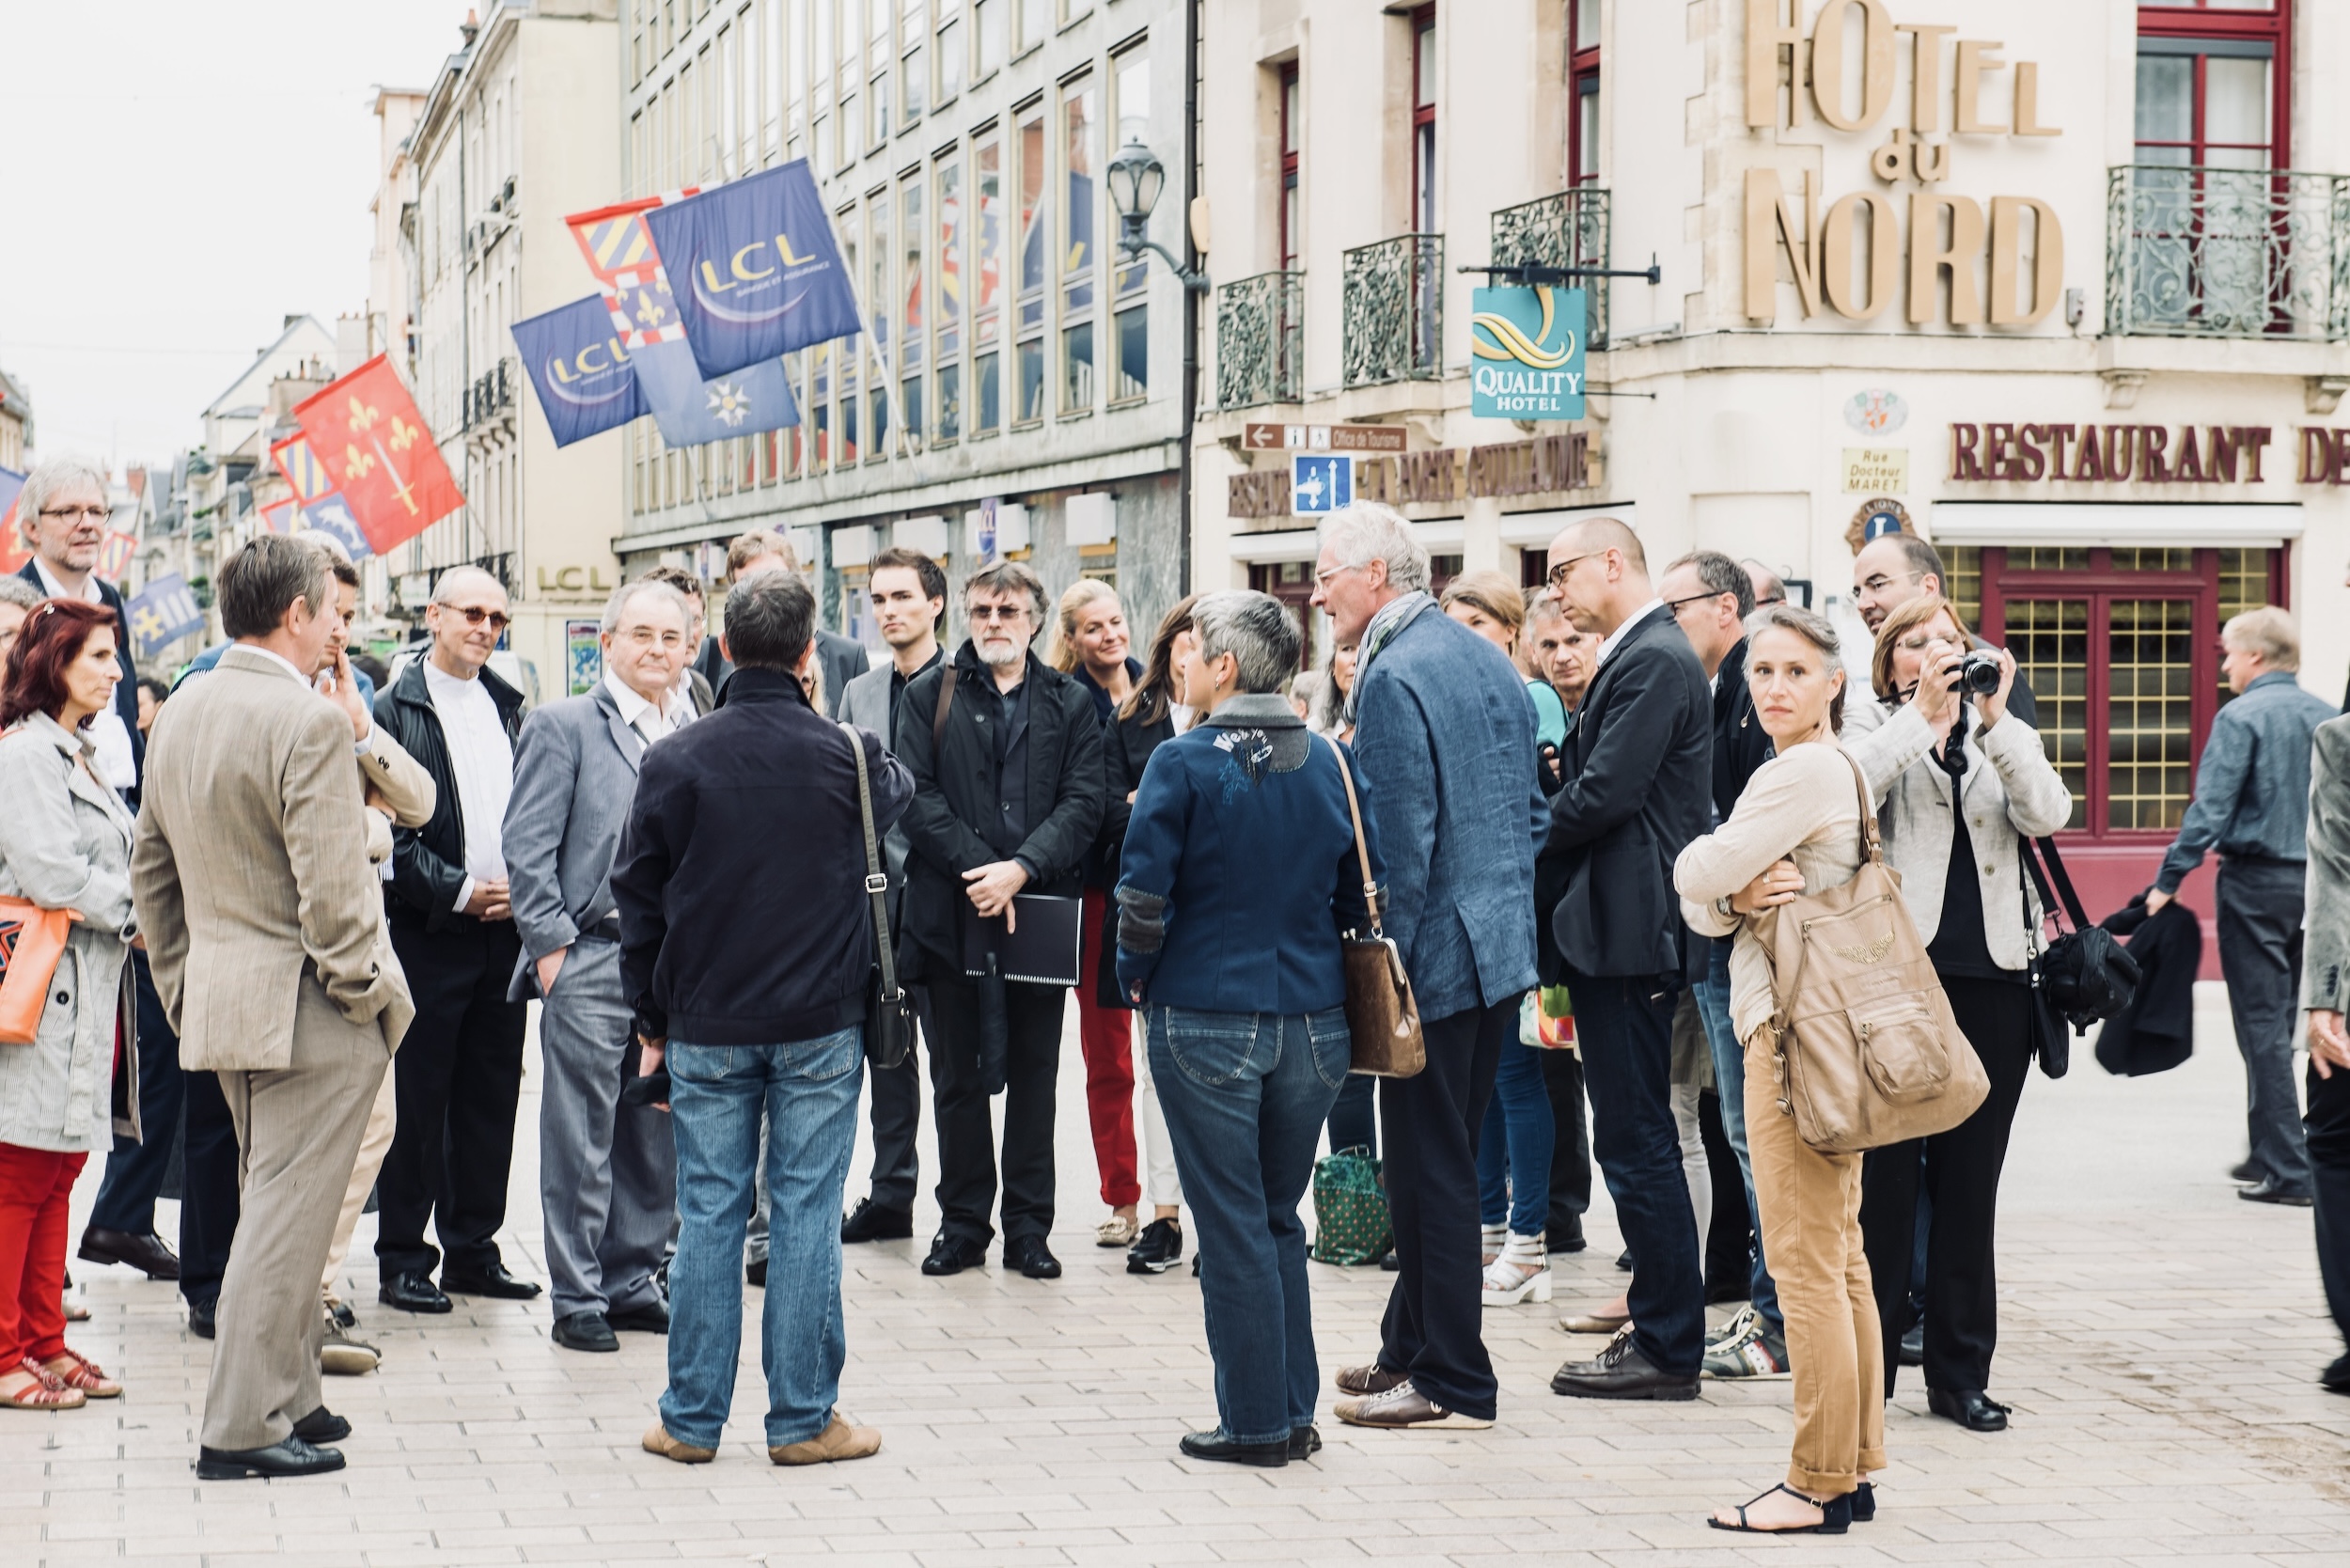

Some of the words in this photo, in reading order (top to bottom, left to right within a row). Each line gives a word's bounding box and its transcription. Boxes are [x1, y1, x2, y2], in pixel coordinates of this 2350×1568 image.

[1745, 0, 2062, 136] HOTEL
[1871, 128, 1949, 181] du
[1744, 168, 2063, 325] NORD
[700, 233, 817, 293] LCL
[553, 337, 631, 384] LCL
[1475, 365, 1582, 398] QUALITY
[1496, 397, 1560, 412] HOTEL
[1333, 429, 1355, 447] Office
[1355, 431, 1367, 447] de
[1367, 431, 1402, 449] Tourisme
[1949, 423, 2272, 483] RESTAURANT
[1850, 463, 1901, 478] Docteur
[1862, 449, 1888, 463] Rue
[1848, 478, 1900, 492] MARET
[1865, 500, 1904, 515] LIONS
[537, 566, 612, 591] LCL
